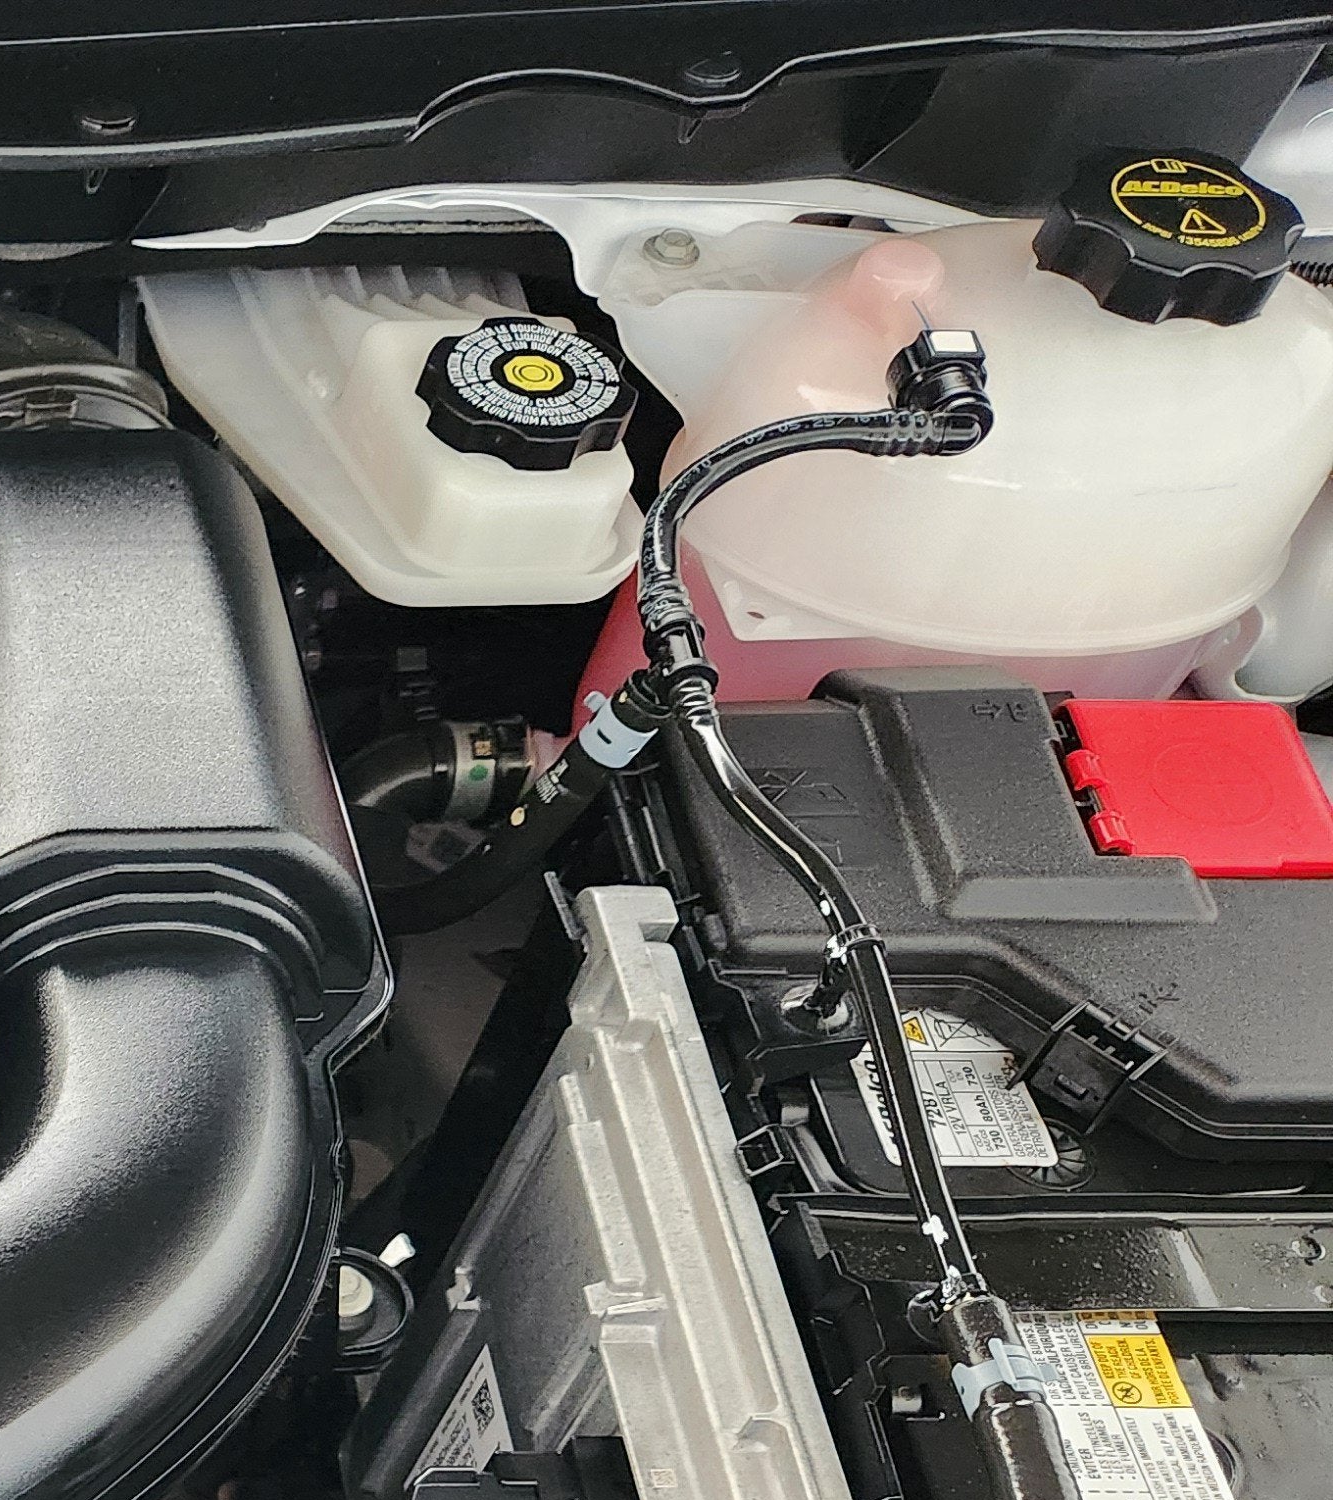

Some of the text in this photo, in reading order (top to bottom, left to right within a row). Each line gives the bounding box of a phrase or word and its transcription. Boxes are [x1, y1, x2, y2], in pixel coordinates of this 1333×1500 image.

[1121, 180, 1244, 196] ACDelco
[962, 1066, 978, 1085] 730
[935, 1081, 967, 1134] 12V VRLA
[973, 1095, 993, 1121] 80Ah
[989, 1089, 1010, 1120] MOTORS
[989, 1130, 1007, 1149] 730
[1056, 1334, 1068, 1344] LA
[1092, 1341, 1115, 1378] KEEP OUT OF
[1135, 1348, 1147, 1356] LA
[1139, 1356, 1151, 1365] DE
[1061, 1347, 1082, 1377] CAUSER
[1107, 1346, 1128, 1378] THE REACH
[1086, 1372, 1098, 1385] DES
[1143, 1367, 1158, 1384] HORS
[1074, 1380, 1091, 1399] PEUT
[1113, 1434, 1131, 1461] FUMER
[1099, 1460, 1113, 1473] LES
[1111, 1460, 1124, 1473] LES
